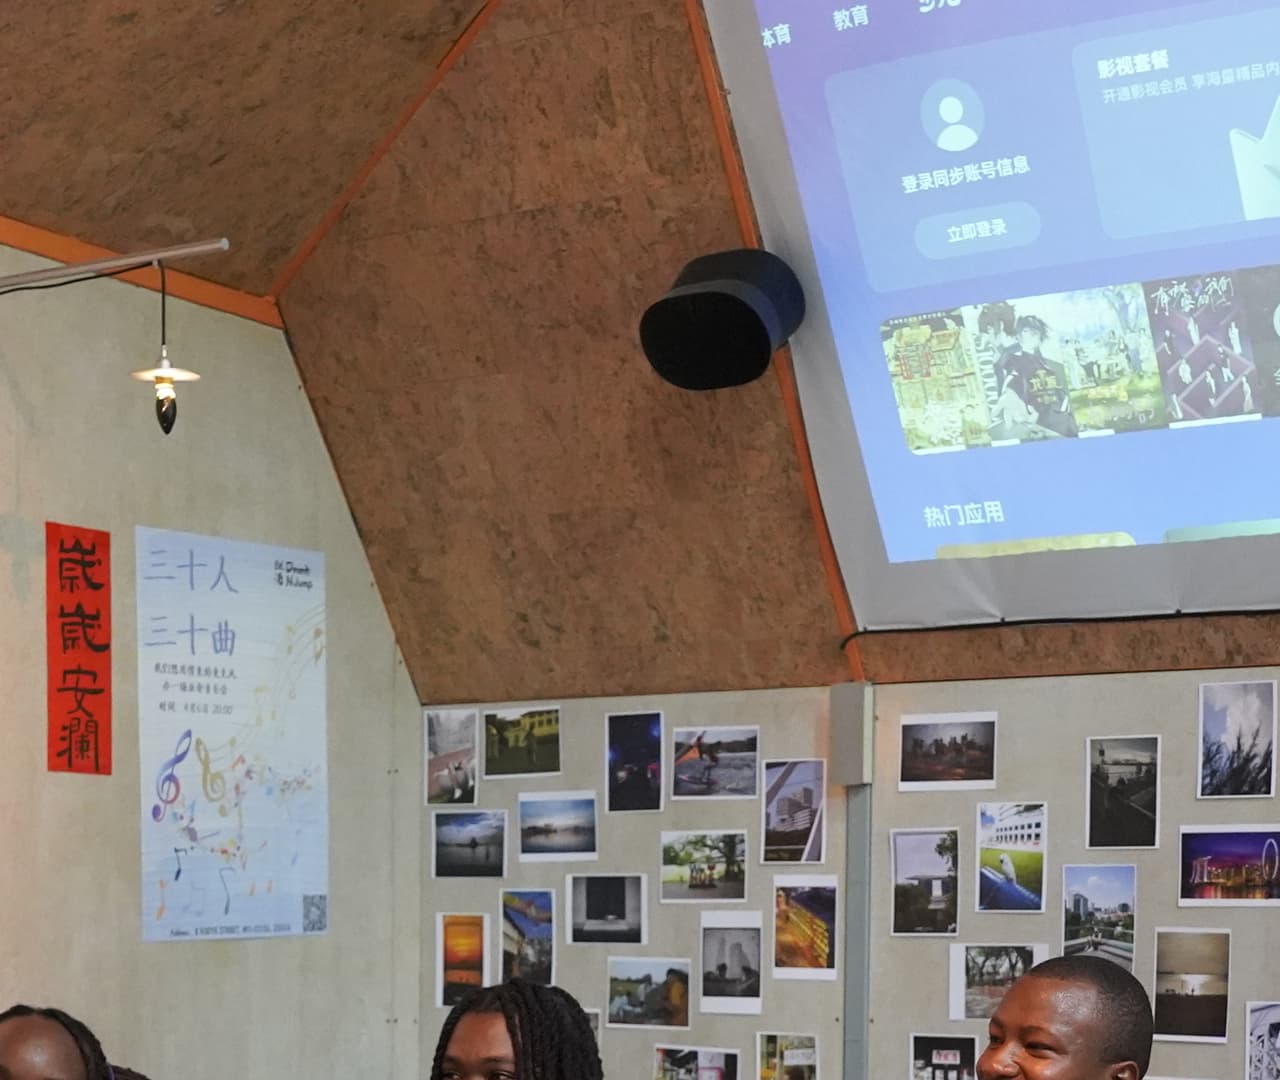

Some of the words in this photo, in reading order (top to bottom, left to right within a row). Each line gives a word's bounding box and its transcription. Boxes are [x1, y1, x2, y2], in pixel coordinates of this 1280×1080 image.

[833, 5, 869, 31] 教育
[1097, 49, 1169, 79] 影视套餐
[901, 155, 1031, 194] 登录同步账号信息
[947, 218, 1008, 243] 立即登录
[923, 500, 1005, 528] 热门应用
[144, 549, 240, 594] 三十人
[144, 613, 237, 656] 三十曲
